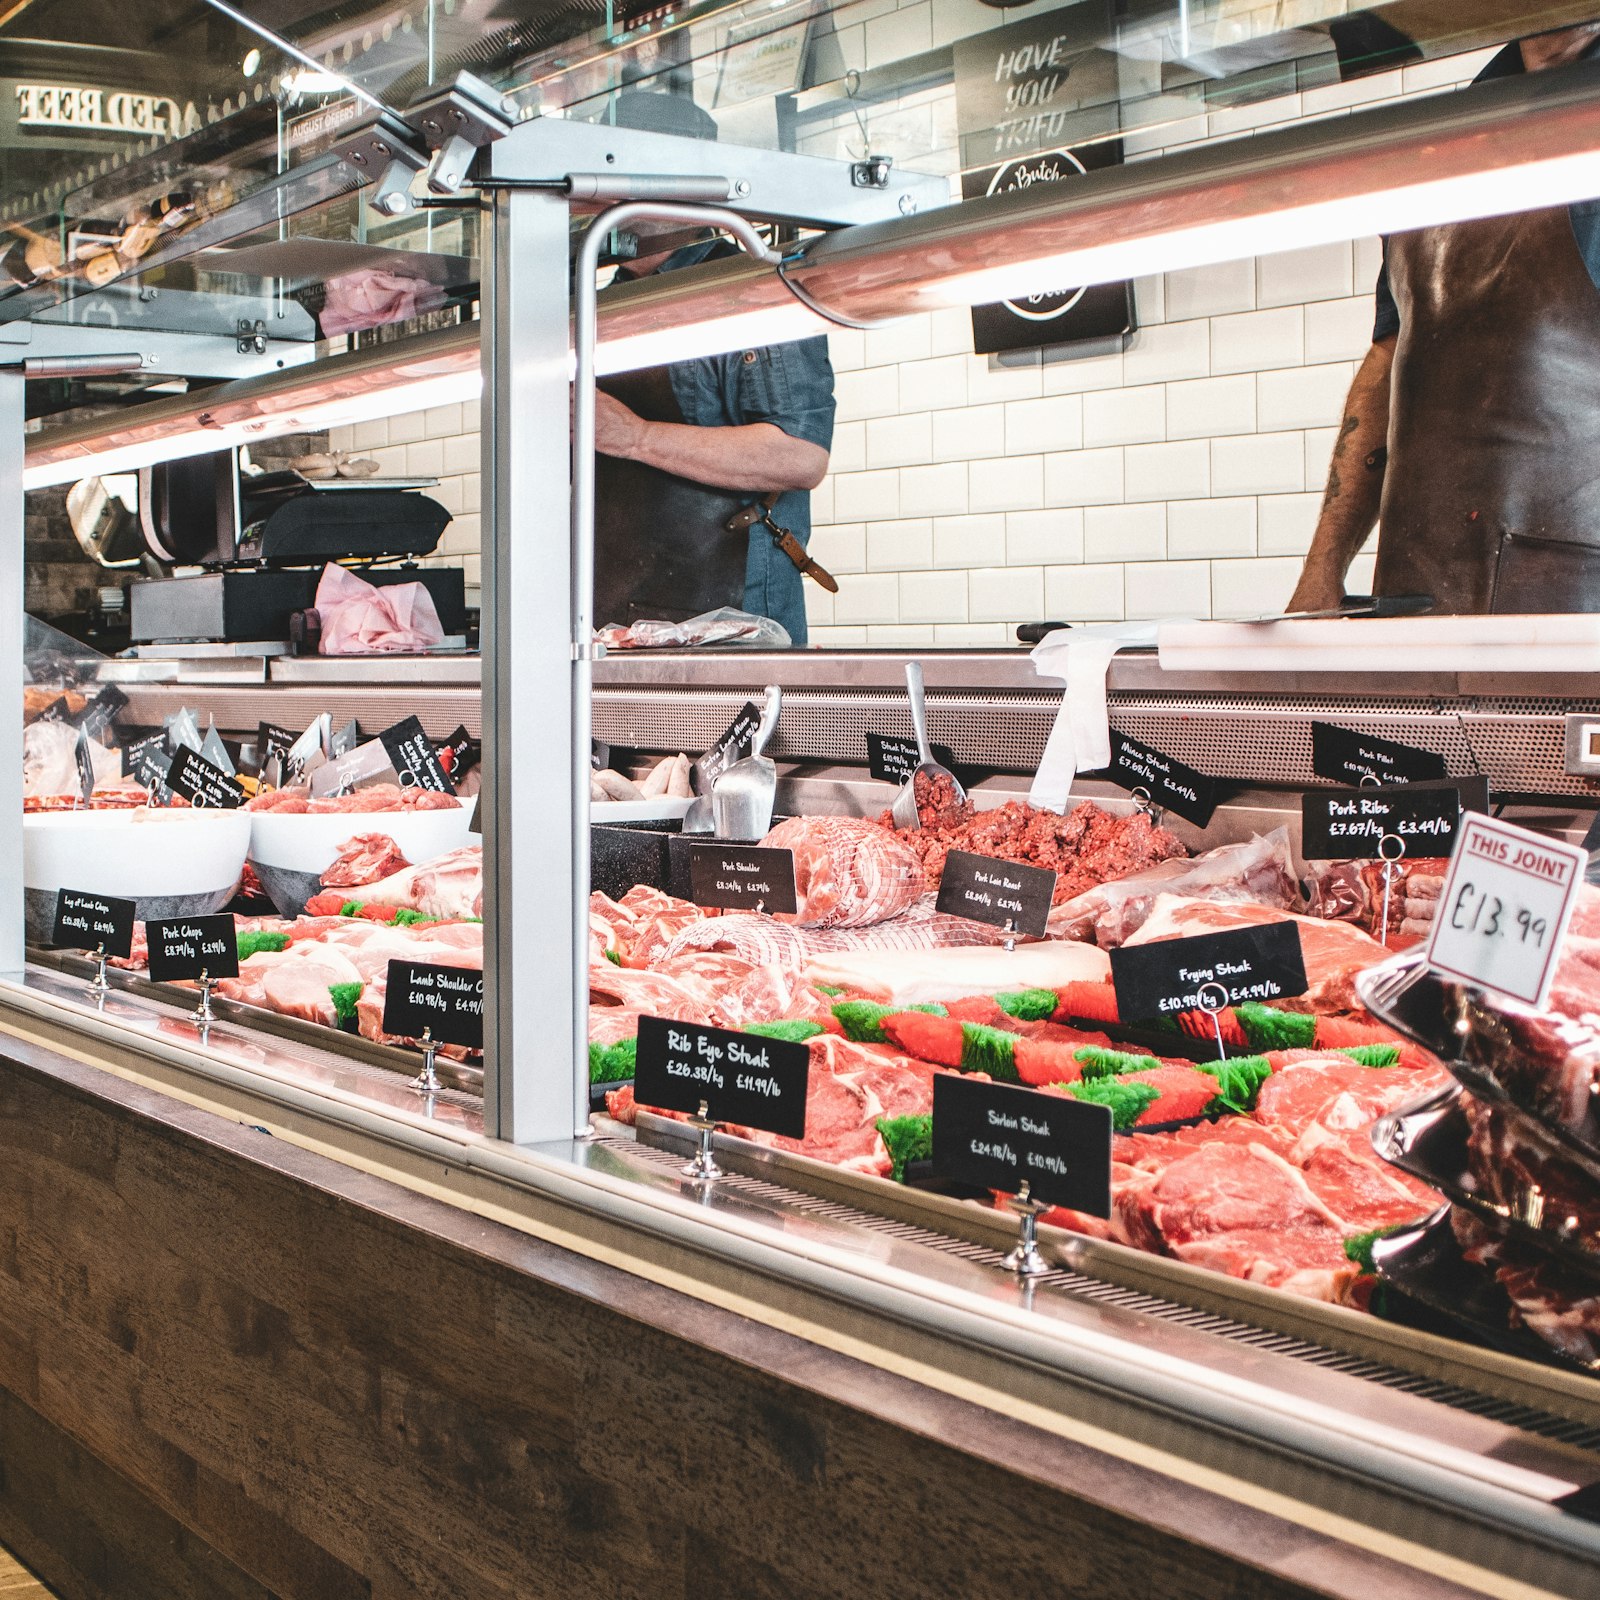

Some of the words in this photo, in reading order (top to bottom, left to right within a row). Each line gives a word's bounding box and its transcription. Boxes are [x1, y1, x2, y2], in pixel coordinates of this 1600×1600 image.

[994, 35, 1067, 82] HAVE
[1005, 73, 1059, 113] YOU
[292, 116, 324, 140] AUGUST
[324, 104, 355, 128] OFFERS
[1120, 742, 1144, 760] Mince
[1145, 753, 1171, 774] Steak
[1359, 747, 1375, 760] Pork
[1119, 755, 1156, 782] £7.68/kg
[1163, 778, 1197, 802] £3.49/lb
[1328, 799, 1358, 816] Pork
[1361, 799, 1390, 815] Ribs
[1329, 818, 1384, 838] £7.67/kg
[1397, 817, 1452, 836] £3.49/lb
[722, 861, 735, 871] Pork
[736, 862, 760, 873] Shoulder
[1472, 832, 1510, 860] THIS
[1513, 850, 1569, 881] JOINT
[974, 871, 988, 883] Pork
[1003, 877, 1021, 891] Roast
[1452, 881, 1547, 948] £13.99
[162, 925, 180, 940] Pork
[181, 925, 203, 940] Chops
[409, 969, 434, 987] Lamb
[437, 973, 473, 992] Shoulder
[1178, 967, 1214, 983] Frying
[1215, 959, 1252, 977] Steak
[1229, 979, 1281, 1001] £4.99/lb
[408, 991, 447, 1012] £10.98/kg
[455, 998, 484, 1015] £4.99/l
[667, 1029, 692, 1052] Rib
[697, 1036, 724, 1064] Eye
[727, 1042, 770, 1068] Steak
[666, 1060, 724, 1088] £26.38/kg
[736, 1074, 782, 1097] £11.99/lb
[987, 1109, 1018, 1130] Sirloin
[1020, 1116, 1050, 1136] Steak
